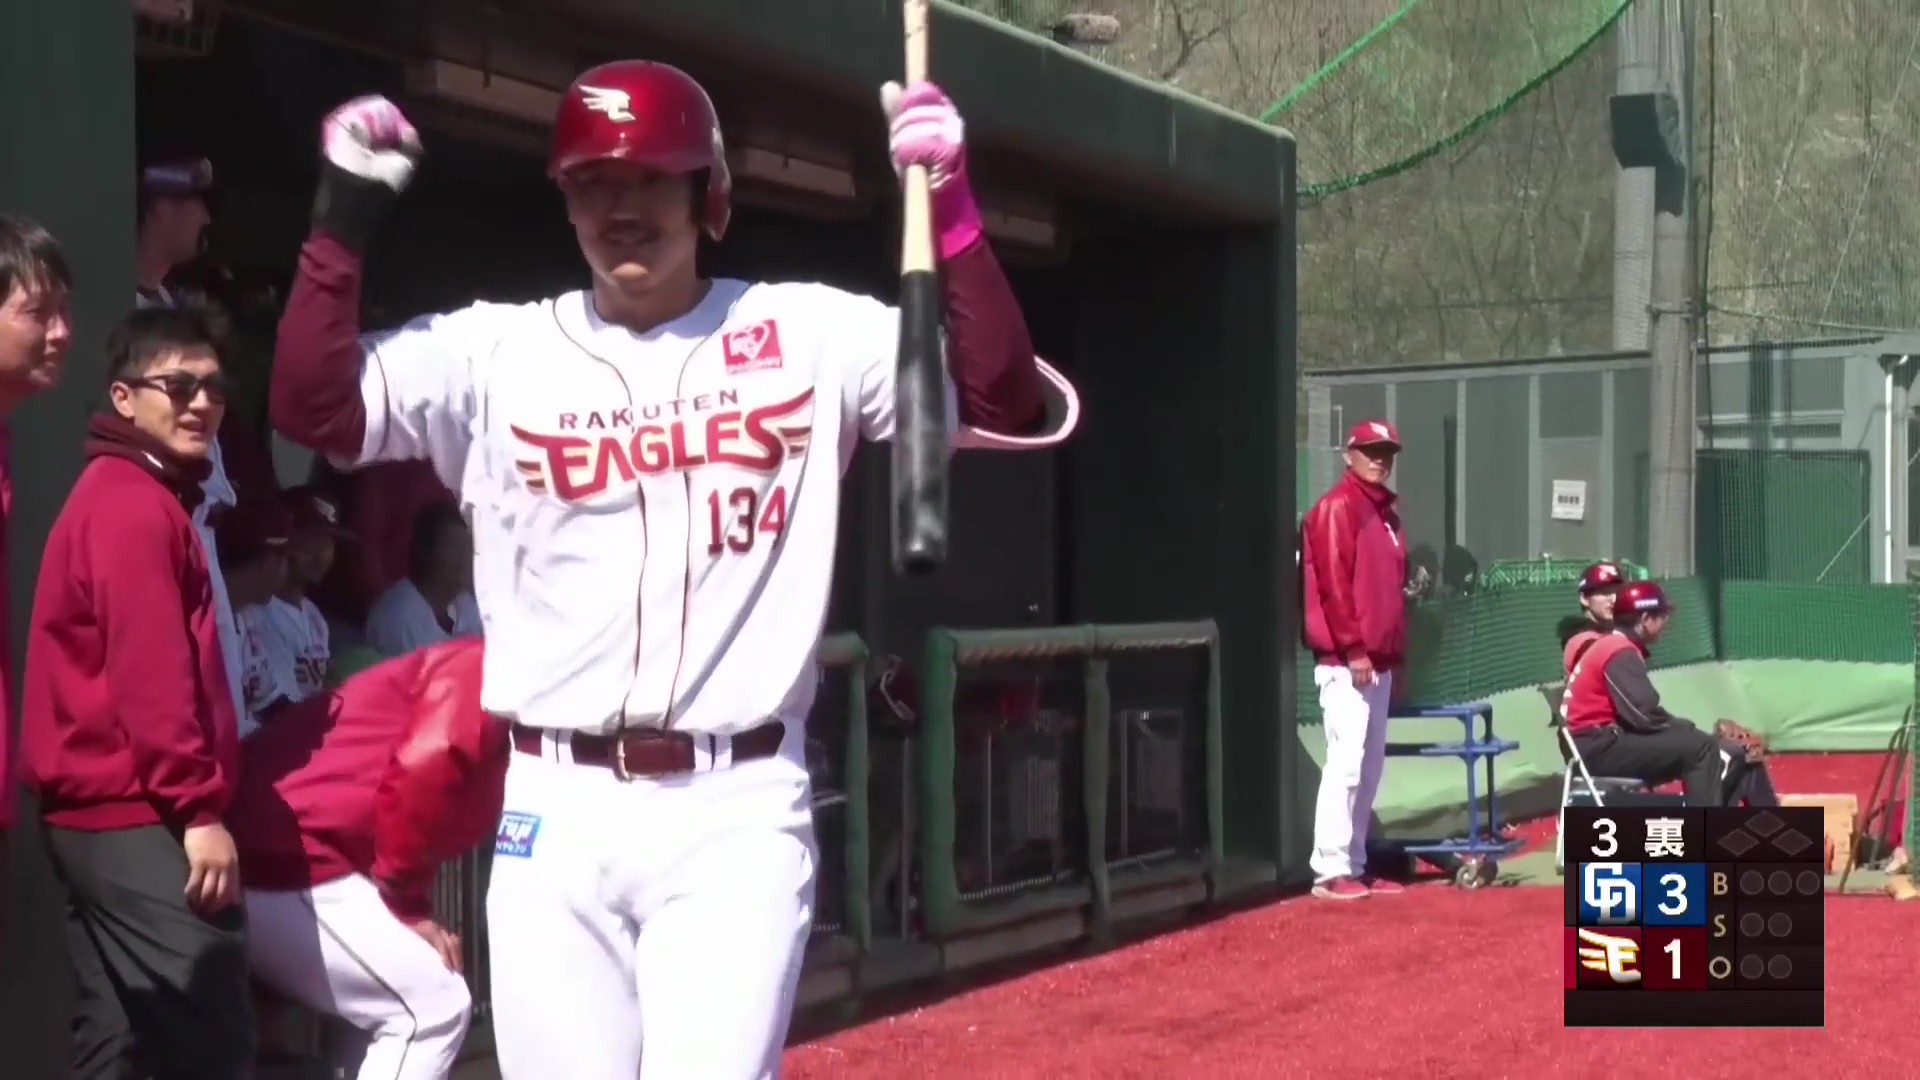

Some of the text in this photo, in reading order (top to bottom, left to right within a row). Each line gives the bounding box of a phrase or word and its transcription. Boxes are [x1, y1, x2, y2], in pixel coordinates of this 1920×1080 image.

[516, 388, 815, 501] EAGLES
[558, 388, 740, 431] RAKUTEN
[707, 485, 787, 556] 134
